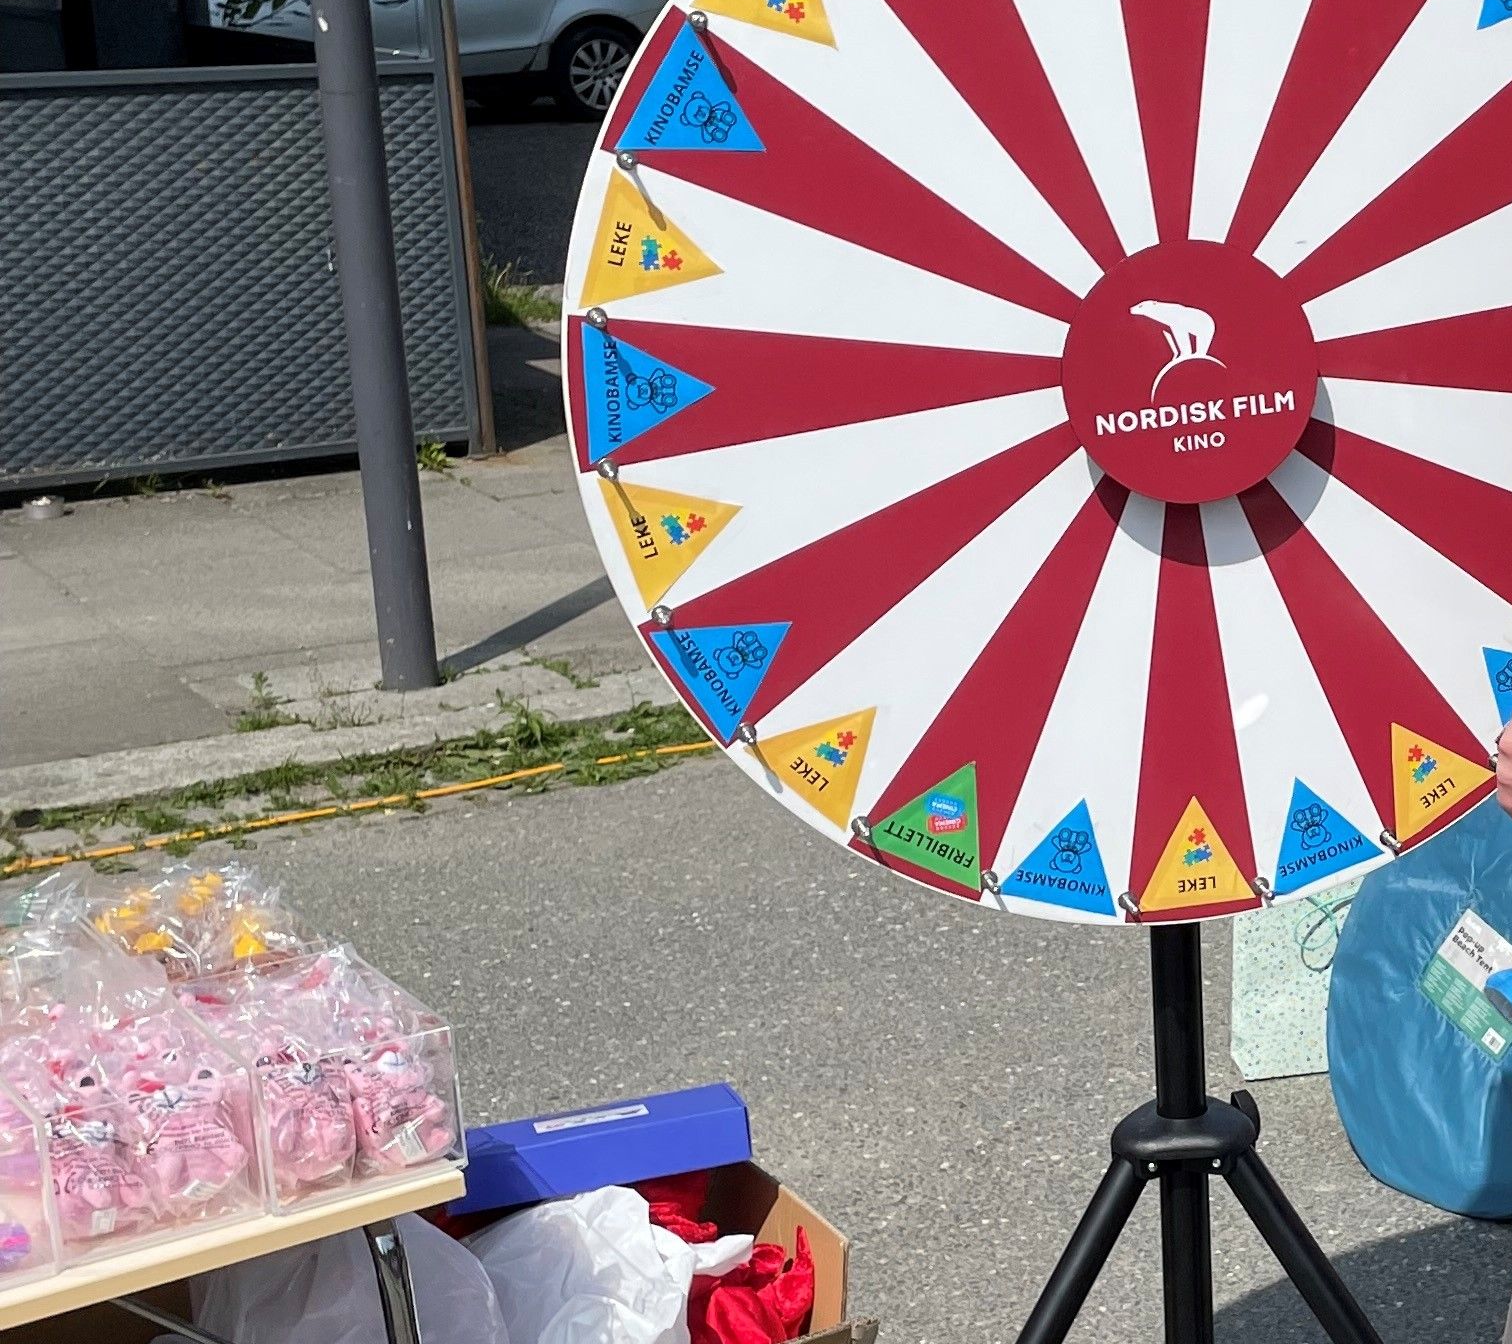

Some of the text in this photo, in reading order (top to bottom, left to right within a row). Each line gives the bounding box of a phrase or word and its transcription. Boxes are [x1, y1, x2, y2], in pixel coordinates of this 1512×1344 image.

[645, 48, 706, 146] KINOBAMSE
[607, 221, 632, 267] LEKE
[606, 340, 621, 444] KINOBAMSE
[1095, 390, 1295, 437] NORDISK FILM
[1173, 431, 1226, 454] KINO
[635, 514, 660, 560] LEKE
[679, 631, 741, 717] KINOBAMSE
[789, 756, 829, 791] LEKE
[1420, 778, 1456, 809] LEKE
[883, 820, 975, 869] FRIBILLETT
[1280, 835, 1364, 878] KINOBAMSE
[1016, 869, 1107, 897] KINOBAMSE
[1177, 875, 1217, 894] LEKE
[1452, 934, 1493, 973] Beach Tent
